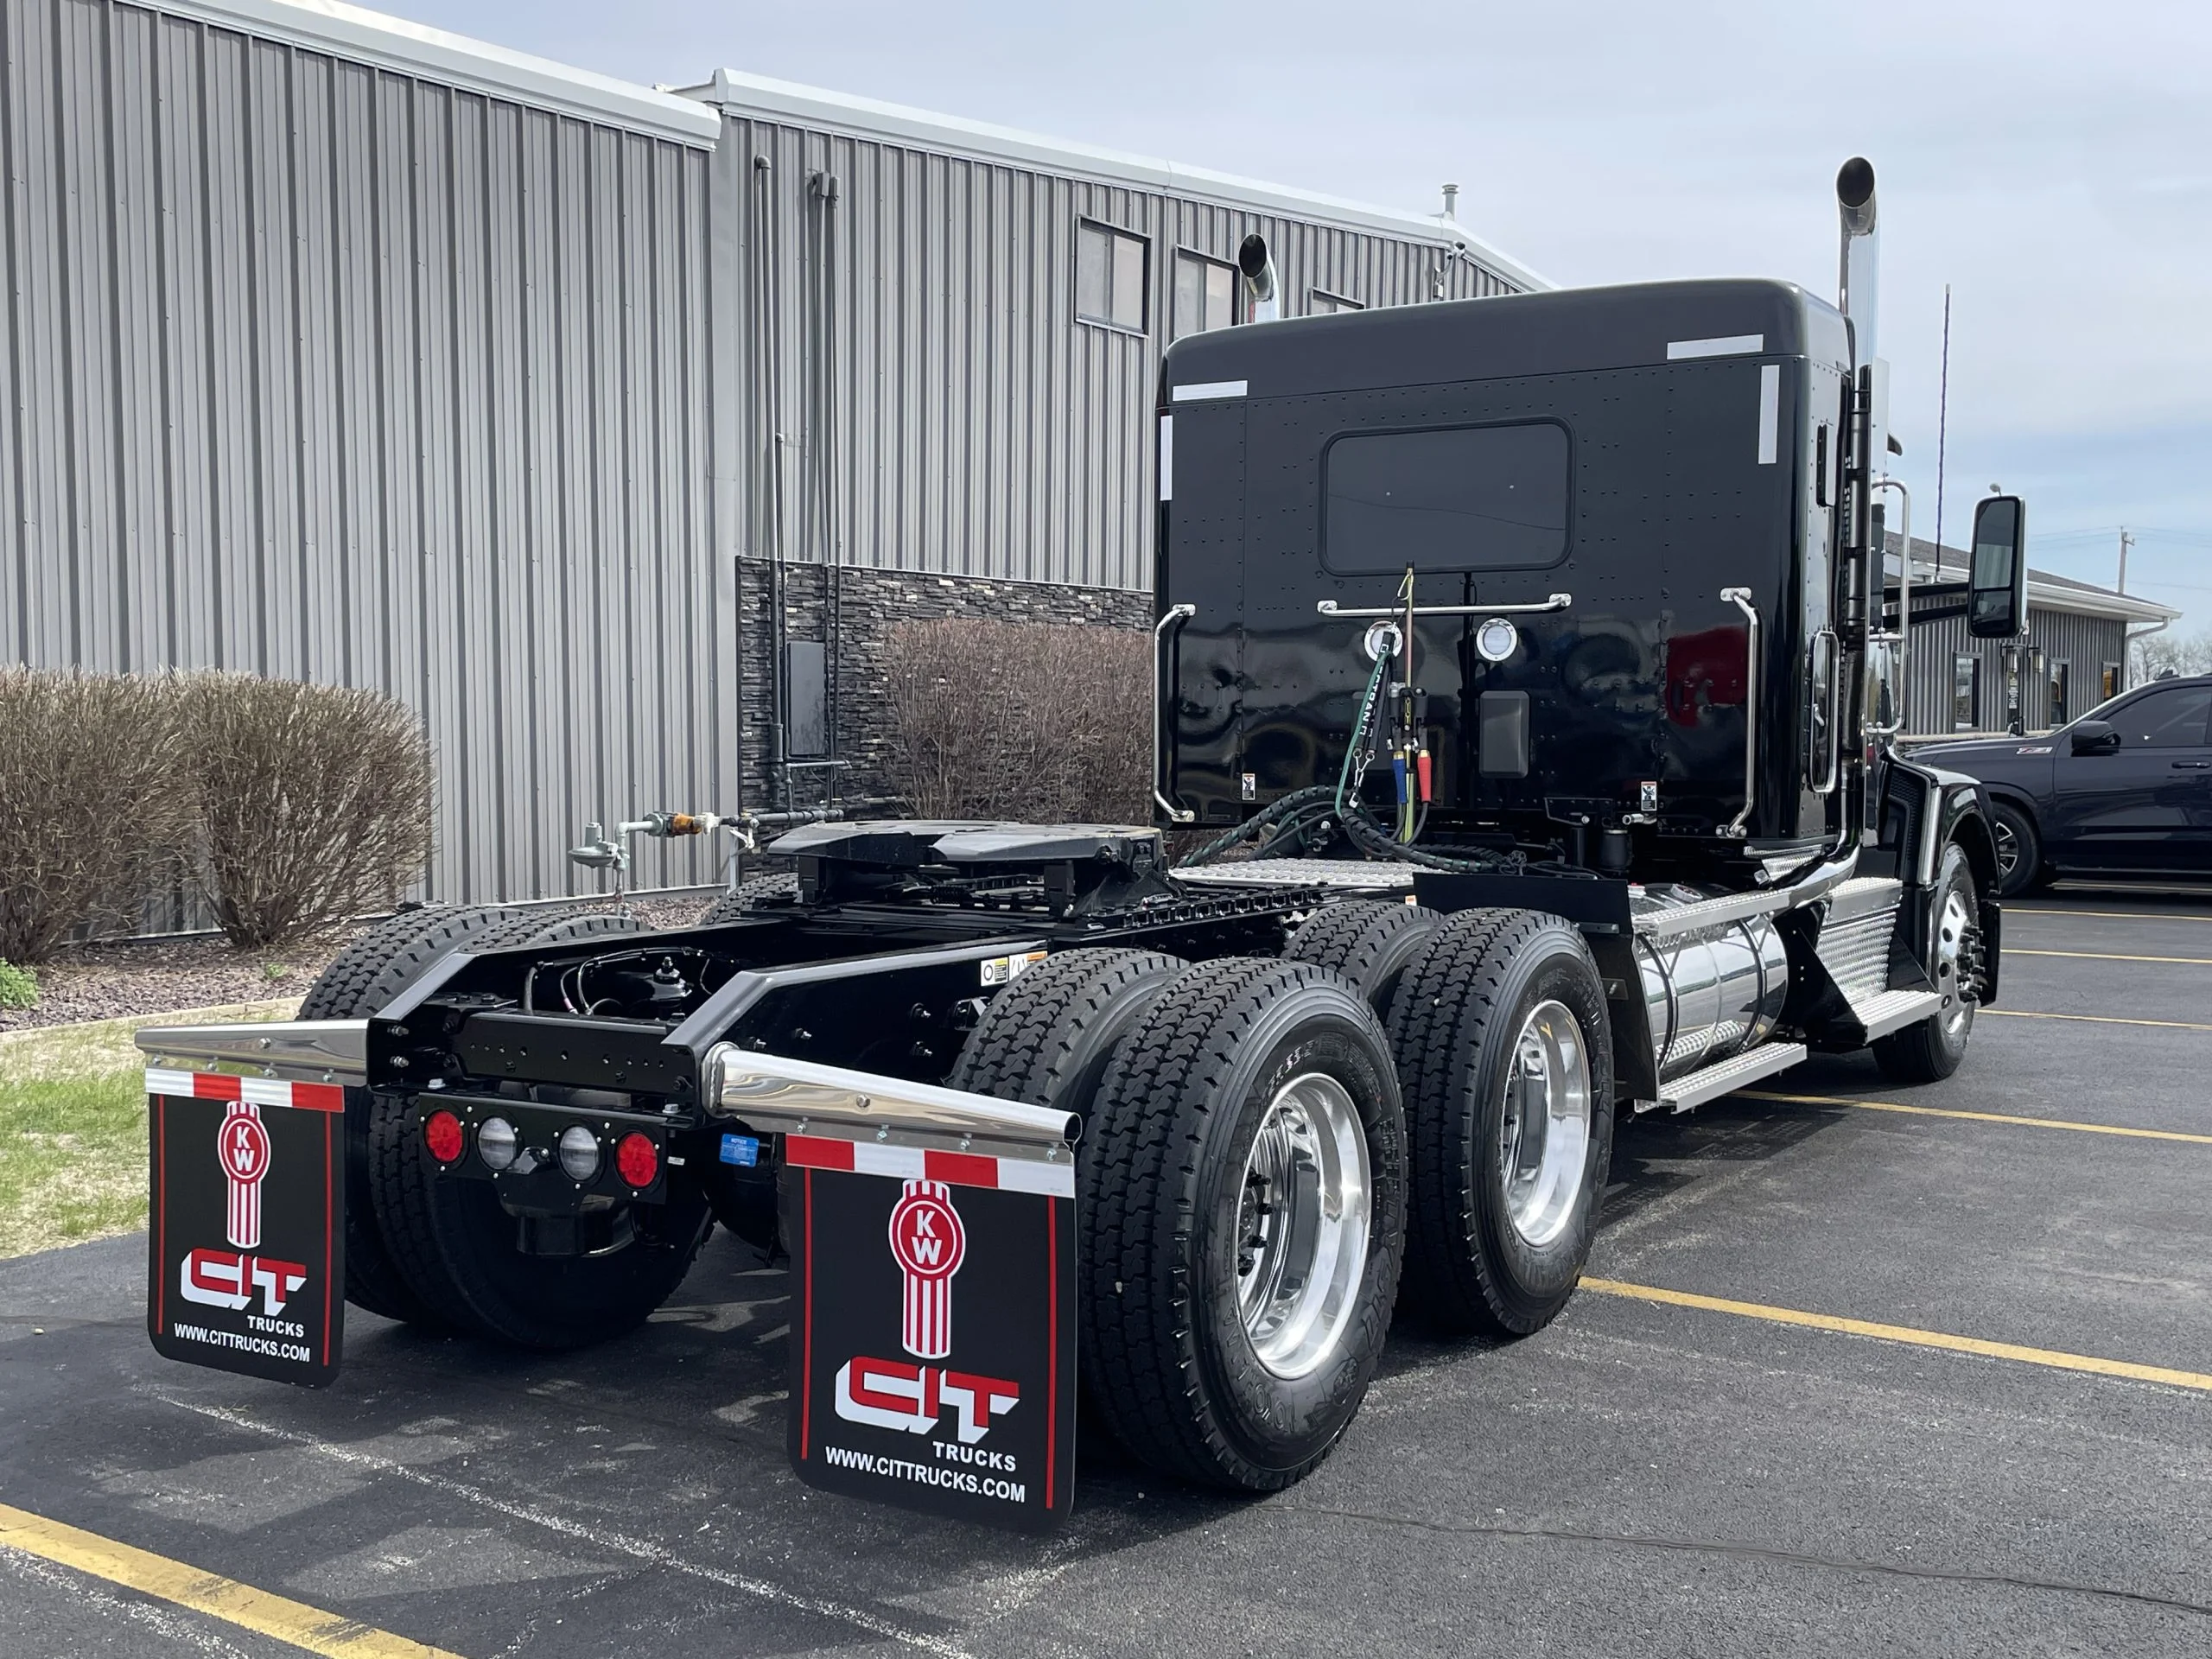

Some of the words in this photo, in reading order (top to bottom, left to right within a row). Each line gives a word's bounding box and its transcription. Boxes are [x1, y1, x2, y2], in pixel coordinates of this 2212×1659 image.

[181, 1247, 308, 1316] CIT
[175, 1322, 310, 1363] WWW.CITTRUCKS.COM
[247, 1315, 304, 1337] TRUCKS
[835, 1355, 1020, 1444] CIT
[825, 1446, 1026, 1503] WWW.CITTRUCKS.COM
[933, 1440, 1016, 1471] TRUCKS
